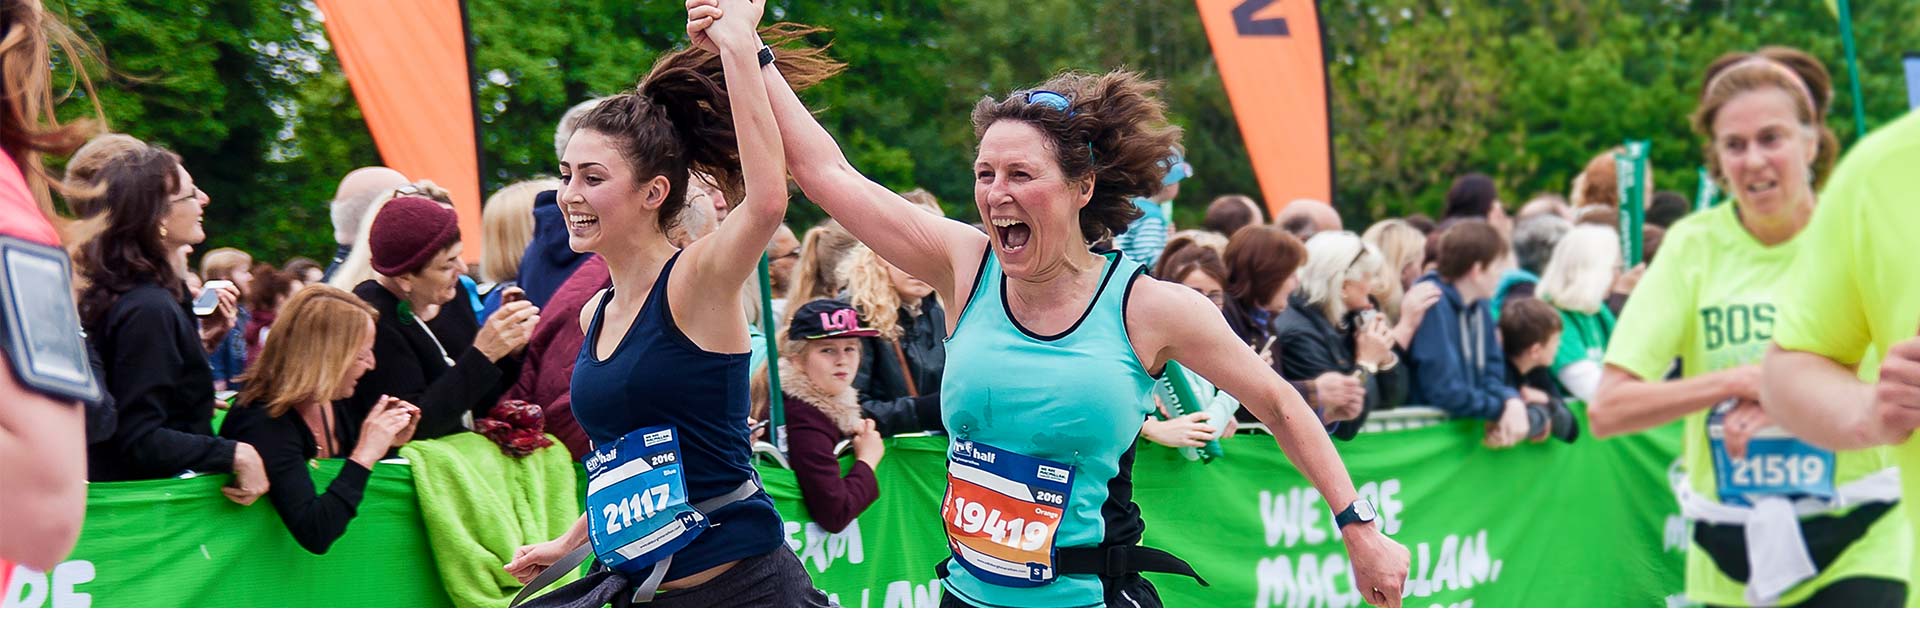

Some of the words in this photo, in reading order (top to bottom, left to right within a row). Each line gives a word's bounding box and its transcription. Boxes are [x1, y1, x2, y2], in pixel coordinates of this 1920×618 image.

[1699, 303, 1776, 350] BOS
[600, 448, 617, 464] half
[651, 452, 675, 466] 2016
[973, 448, 996, 464] half
[1732, 454, 1825, 487] 21519
[1036, 491, 1063, 505] 2016
[603, 483, 670, 535] 21117
[1035, 507, 1059, 519] Orange
[953, 497, 1049, 552] 19419
[1259, 488, 1326, 547] WE
[1033, 568, 1040, 576] S
